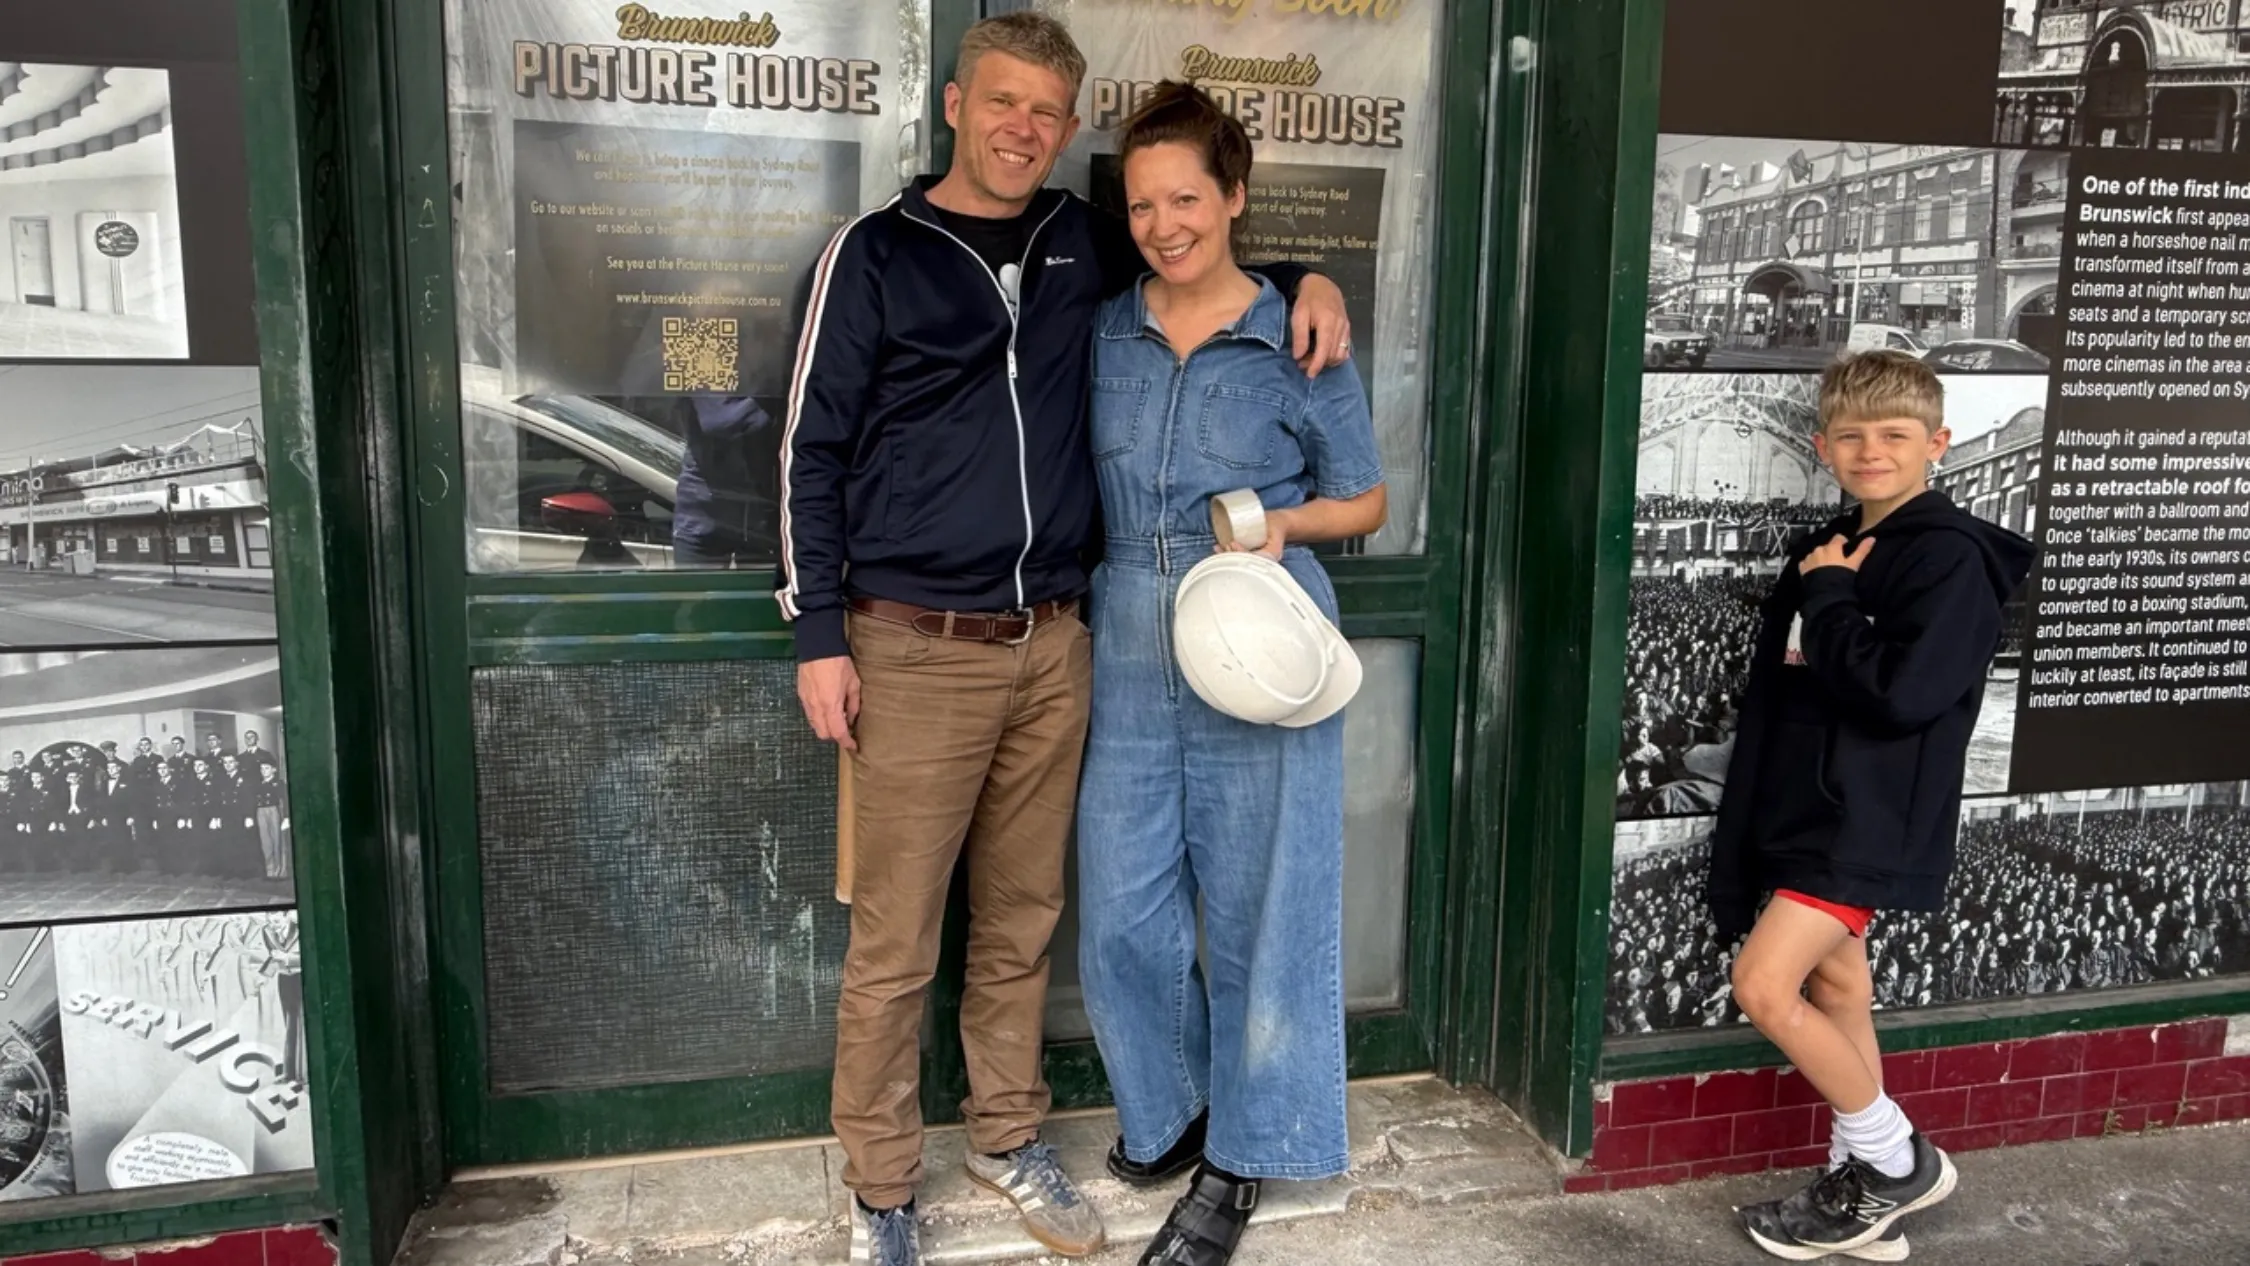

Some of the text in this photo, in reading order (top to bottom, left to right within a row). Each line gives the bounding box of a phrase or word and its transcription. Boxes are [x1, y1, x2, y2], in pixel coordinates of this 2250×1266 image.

[616, 2, 780, 48] Brunswick
[1181, 44, 1322, 86] Brunswick
[513, 40, 880, 115] PICTURE HOUSE
[1273, 89, 1405, 148] HOUSE
[2082, 175, 2250, 200] One of the first ind
[530, 200, 546, 215] Go
[547, 202, 558, 215] to
[560, 204, 577, 216] our
[579, 202, 614, 216] website
[616, 206, 627, 217] or
[2079, 203, 2250, 229] Brunswick first appea
[595, 221, 654, 235] on socials or
[2076, 229, 2116, 248] when
[2119, 233, 2129, 248] a
[2131, 231, 2208, 251] horseshoe
[2209, 233, 2237, 252] nail
[606, 256, 623, 270] See
[625, 259, 644, 272] you
[646, 258, 656, 270] at
[658, 257, 674, 271] the
[676, 257, 708, 272] Picture
[711, 259, 738, 272] House
[742, 262, 760, 275] very
[2074, 254, 2164, 274] transformed
[2166, 256, 2204, 275] itself
[2205, 257, 2239, 276] from
[616, 290, 782, 307] www.brunswickpicturehouse.com.au
[2071, 279, 2125, 298] cinema
[2127, 282, 2144, 298] at
[2146, 280, 2185, 303] night
[2187, 282, 2226, 300] when
[2068, 306, 2109, 322] seats
[2111, 305, 2139, 323] and
[2141, 308, 2151, 323] a
[2154, 307, 2228, 328] temporary
[2065, 330, 2086, 347] Its
[2087, 329, 2161, 351] popularity
[2163, 330, 2186, 348] led
[2189, 332, 2205, 348] to
[2208, 331, 2232, 349] the
[2063, 354, 2243, 374] more cinemas in the area
[2060, 379, 2156, 401] subsequently
[2158, 380, 2211, 401] opened
[2212, 383, 2231, 398] on
[2055, 429, 2121, 450] Although
[2124, 428, 2135, 446] it
[2138, 429, 2186, 450] gained
[2187, 432, 2197, 446] a
[2053, 452, 2250, 474] it had some impressive
[2050, 476, 2250, 497] as a retractable roof fo
[2049, 500, 2250, 524] together with a ballroom and
[2045, 527, 2083, 545] Once
[2143, 525, 2200, 543] became
[2202, 524, 2227, 541] the
[2228, 527, 2250, 541] mo
[2043, 551, 2058, 568] in
[2061, 550, 2085, 568] the
[2087, 550, 2123, 570] early
[2126, 549, 2167, 567] 1930s,
[2169, 548, 2188, 565] its
[2190, 550, 2241, 565] owners
[2041, 571, 2236, 595] to upgrade its sound system
[2038, 592, 2249, 616] converted to a boxing stadium,
[2035, 621, 2064, 639] and
[2065, 620, 2123, 638] became
[2124, 621, 2143, 636] an
[2145, 617, 2215, 638] important
[2033, 638, 2248, 663] union members. It continued to
[2031, 659, 2248, 687] luckily at least, its façade is still
[2028, 683, 2250, 709] interior converted to apartments
[62, 991, 303, 1135] SERVICE
